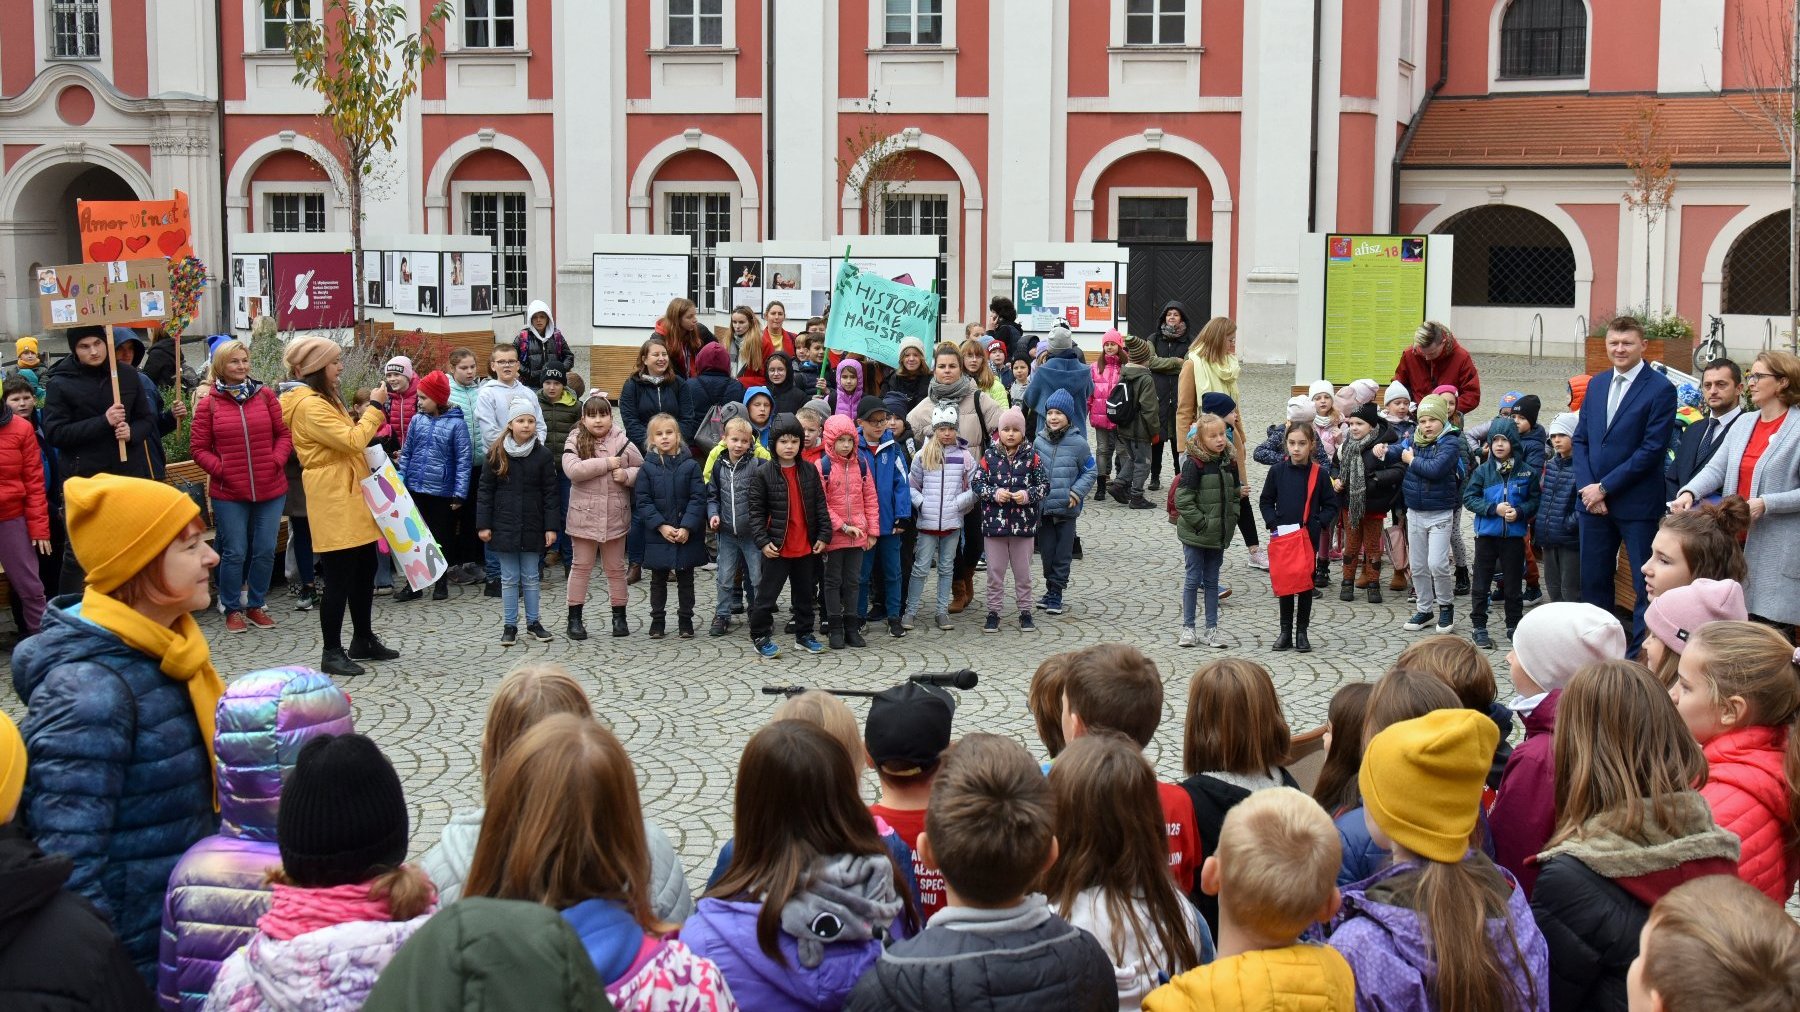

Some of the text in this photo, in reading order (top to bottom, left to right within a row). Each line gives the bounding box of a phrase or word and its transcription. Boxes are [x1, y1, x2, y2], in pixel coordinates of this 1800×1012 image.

[80, 207, 128, 232] Amor
[1355, 241, 1381, 256] afisz
[856, 281, 930, 320] HISTORIA
[844, 312, 905, 343] MAGISTR
[862, 302, 901, 328] VITAE
